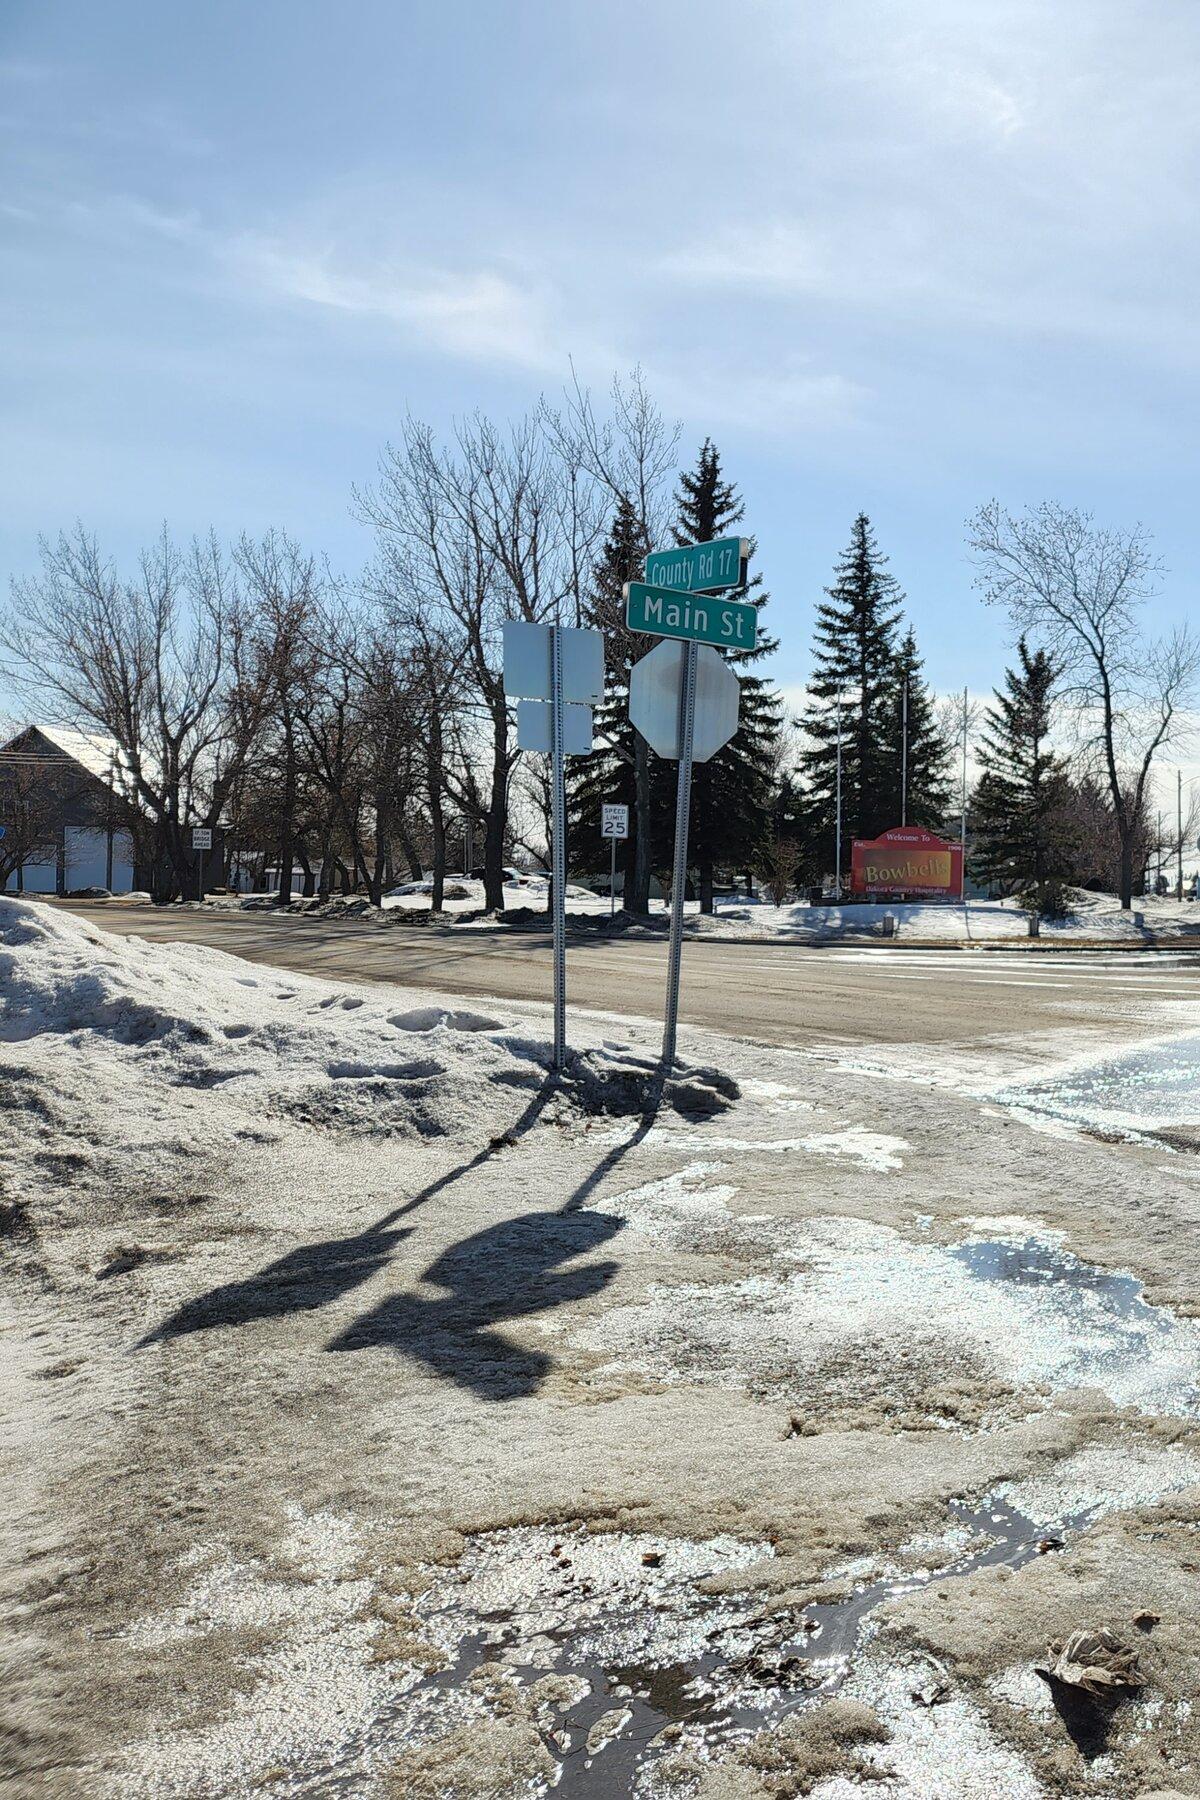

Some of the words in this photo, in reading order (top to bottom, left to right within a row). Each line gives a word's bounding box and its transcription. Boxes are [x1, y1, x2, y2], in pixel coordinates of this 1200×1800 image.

[652, 557, 694, 589] County
[699, 550, 714, 580] Rd
[720, 549, 733, 575] 17
[644, 595, 708, 632] Main
[720, 611, 744, 638] St
[604, 821, 626, 834] 25
[886, 833, 919, 842] Welcome
[921, 834, 931, 842] To
[866, 859, 948, 882] Bowbells
